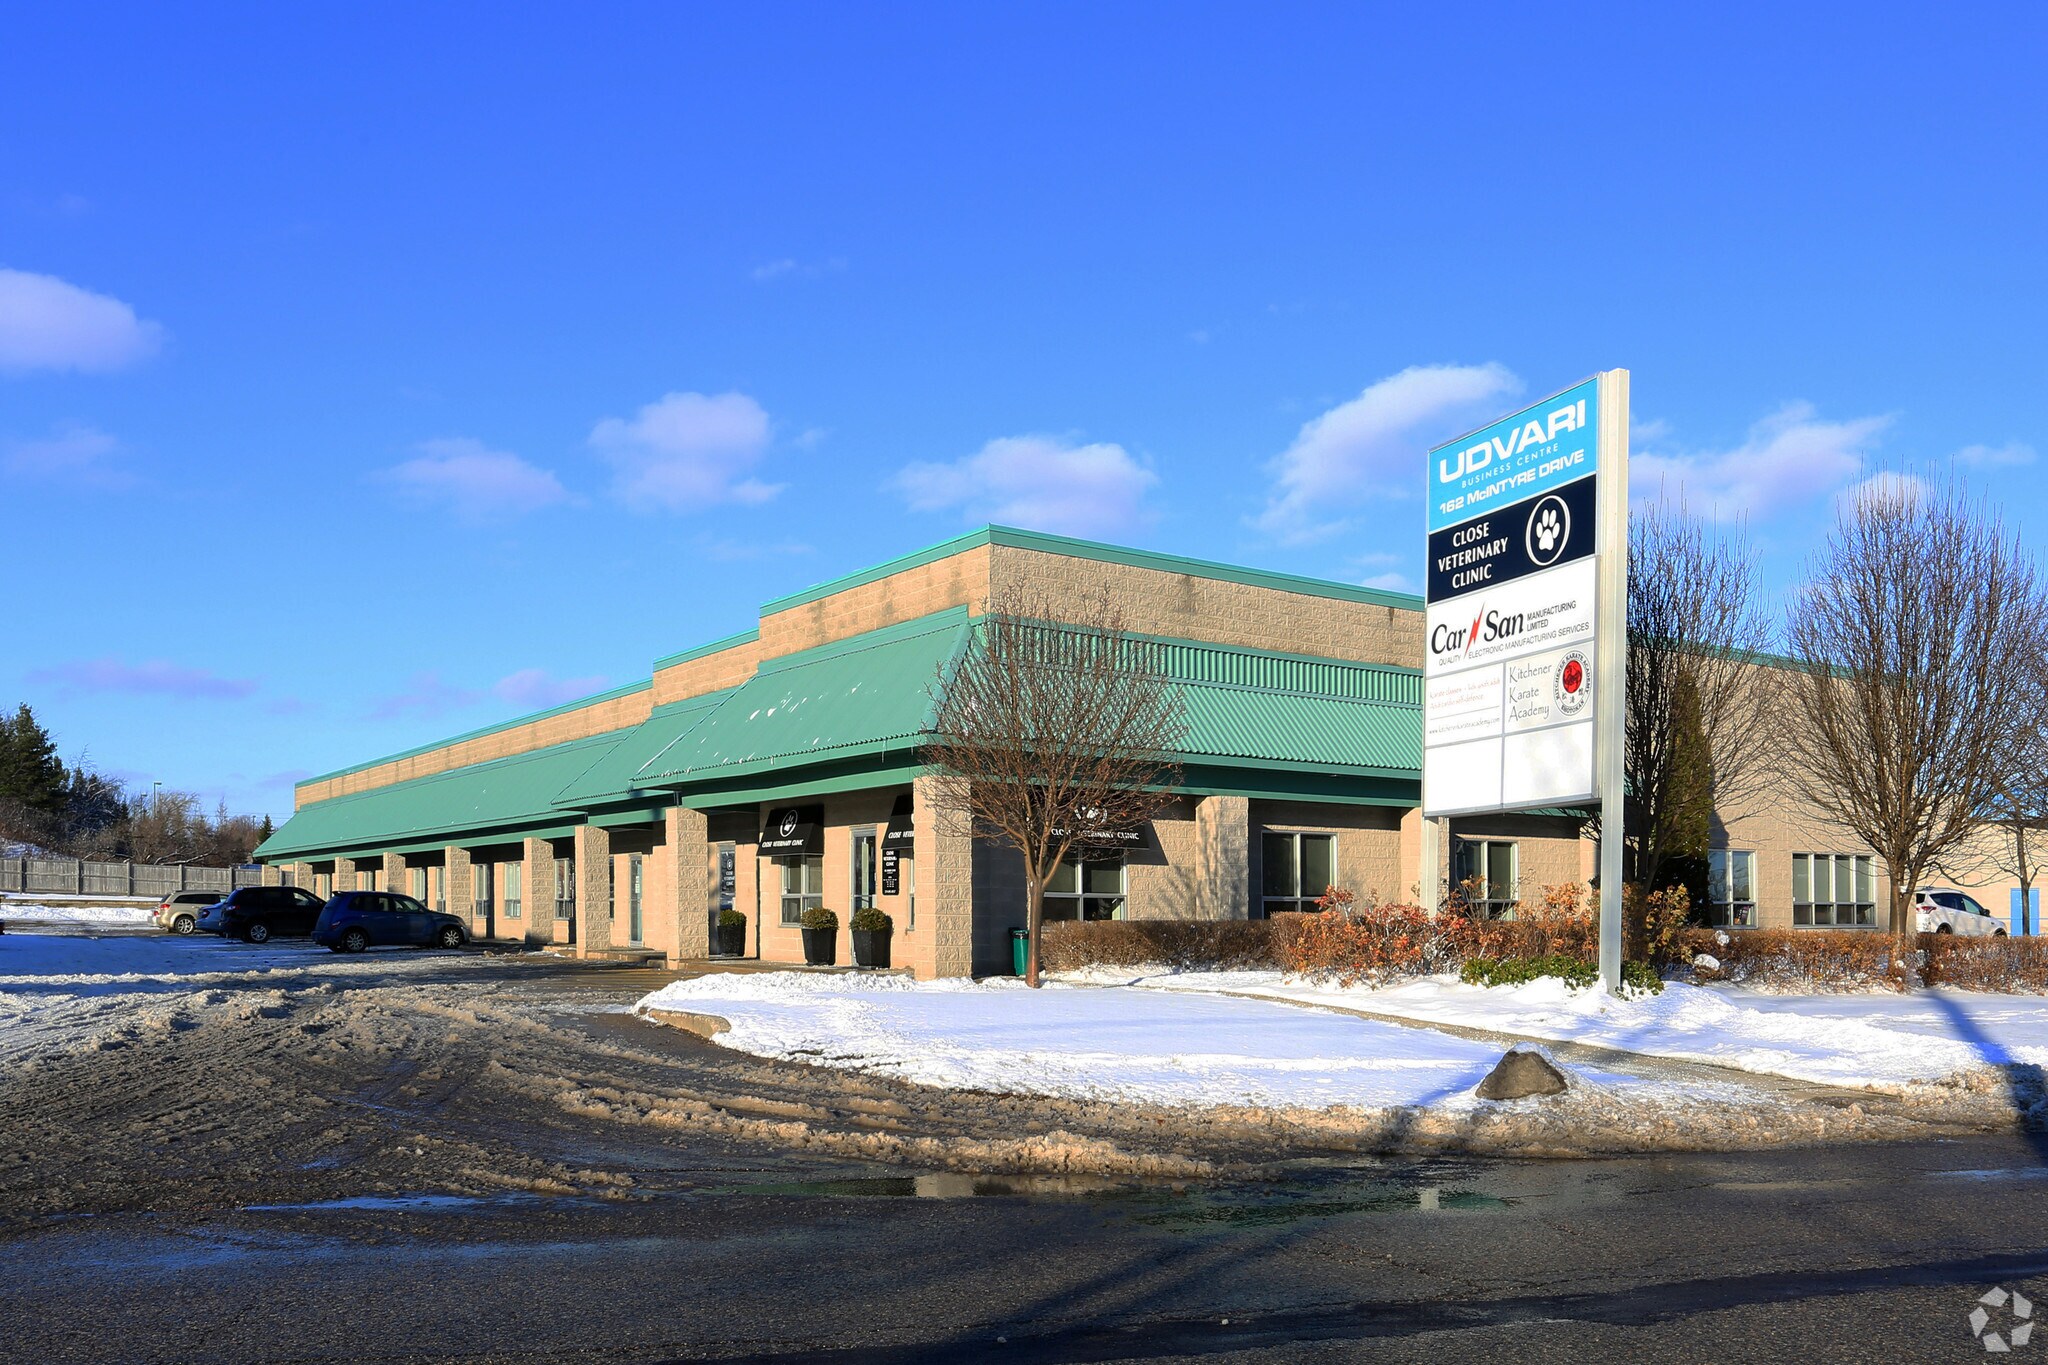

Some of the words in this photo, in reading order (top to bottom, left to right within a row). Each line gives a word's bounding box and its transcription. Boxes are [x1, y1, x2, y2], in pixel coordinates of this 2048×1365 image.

[1439, 399, 1586, 484] UDVARI
[1461, 462, 1511, 489] BUSINESS
[1516, 443, 1559, 466] CENTRE
[1440, 496, 1464, 515] 162
[1467, 468, 1536, 506] McINTYRE
[1538, 449, 1585, 477] DRIVE
[1452, 521, 1490, 548] CLOSE
[1438, 536, 1509, 573] VETERINARY
[1452, 563, 1492, 589] CLINIC
[1526, 600, 1577, 622] MANUFACTURING
[1431, 624, 1467, 655] Car
[1483, 610, 1524, 642] San
[1526, 618, 1549, 632] LIMITED
[1438, 654, 1462, 667] QUALITY
[1468, 643, 1505, 660] ELECTRONIC
[1504, 630, 1557, 650] MANUFACTURING
[1558, 621, 1590, 637] SERVICES
[1509, 662, 1552, 684] Kitchener
[1509, 686, 1540, 704] Karate
[1508, 701, 1550, 722] Academy
